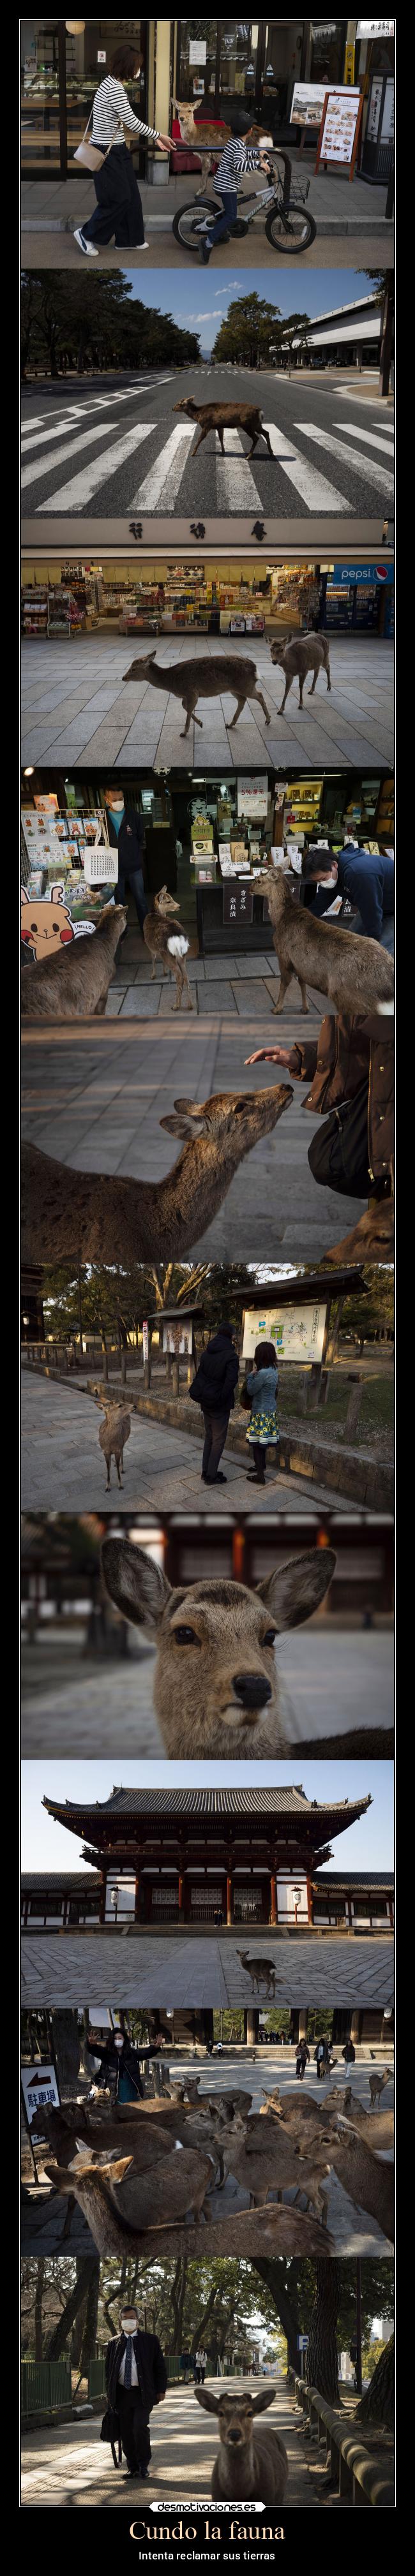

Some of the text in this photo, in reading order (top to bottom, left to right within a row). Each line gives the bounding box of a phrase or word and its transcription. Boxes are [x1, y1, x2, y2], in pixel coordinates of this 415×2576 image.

[342, 569, 370, 580] pepsi
[28, 2089, 56, 2107] 駐車場
